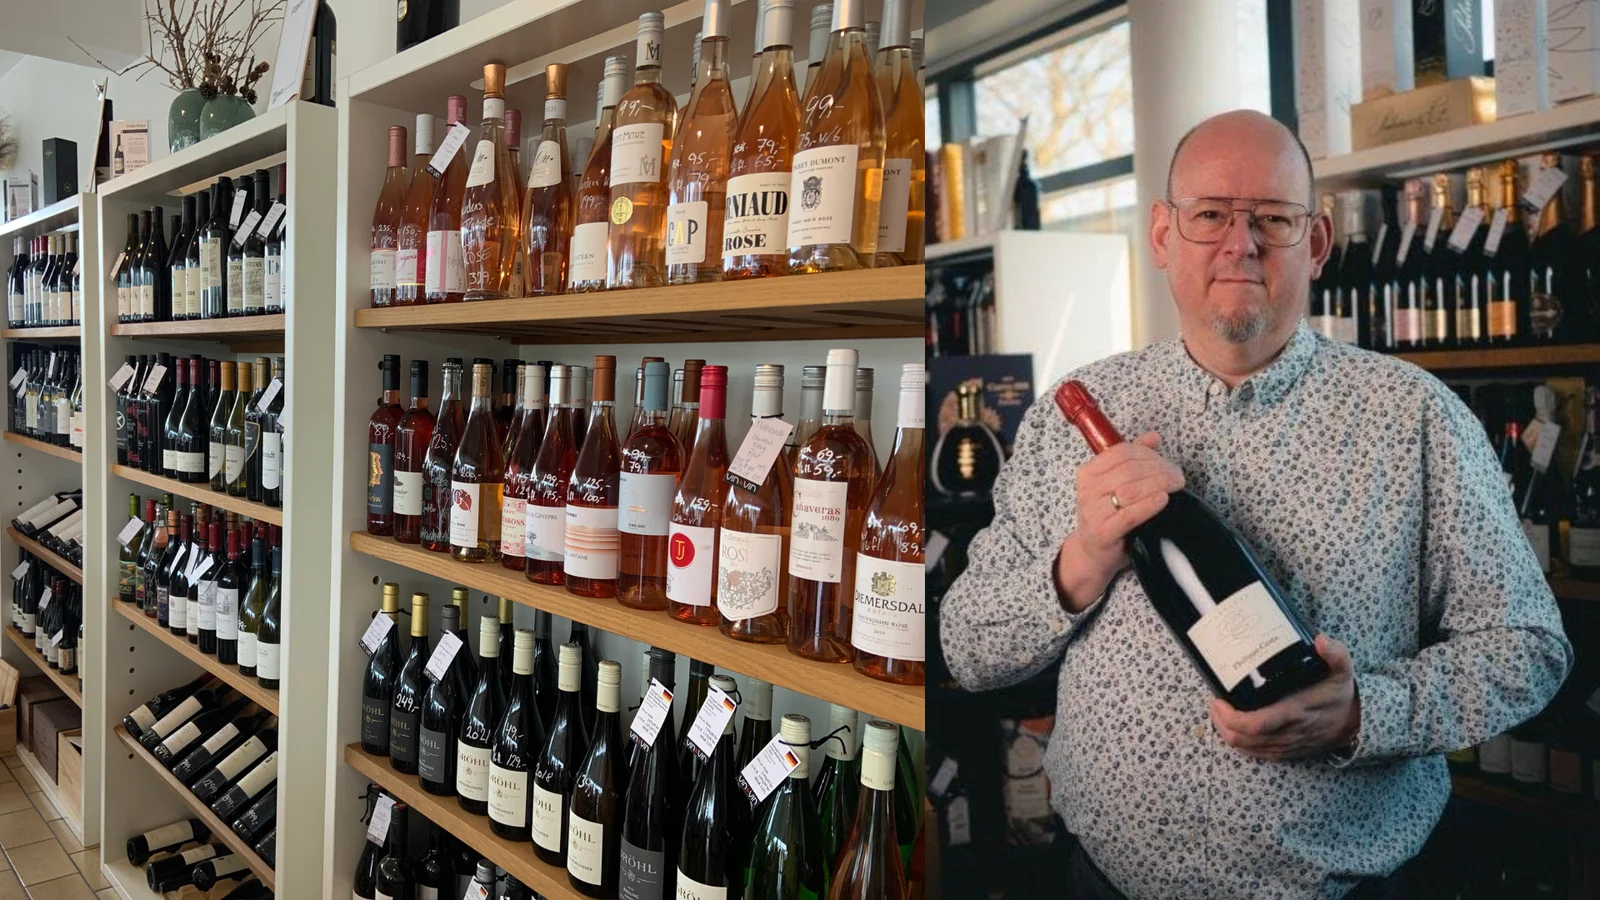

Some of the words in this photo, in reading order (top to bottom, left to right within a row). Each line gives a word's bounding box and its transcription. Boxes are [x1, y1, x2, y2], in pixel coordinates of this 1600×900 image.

[806, 95, 844, 123] 99,-
[757, 138, 786, 155] 79,-
[688, 151, 718, 168] 95,-
[754, 154, 785, 169] 65,-
[810, 156, 847, 167] DUMONT
[668, 219, 699, 247] CAP
[725, 234, 767, 251] ROSE
[816, 447, 843, 464] 69,-
[813, 463, 842, 480] 59,-
[690, 497, 719, 512] 159,-
[791, 490, 841, 517] Cañaveras
[901, 542, 925, 558] 89,-
[396, 693, 420, 714] 249,-
[466, 726, 490, 744] 2021
[535, 763, 554, 782] 2018
